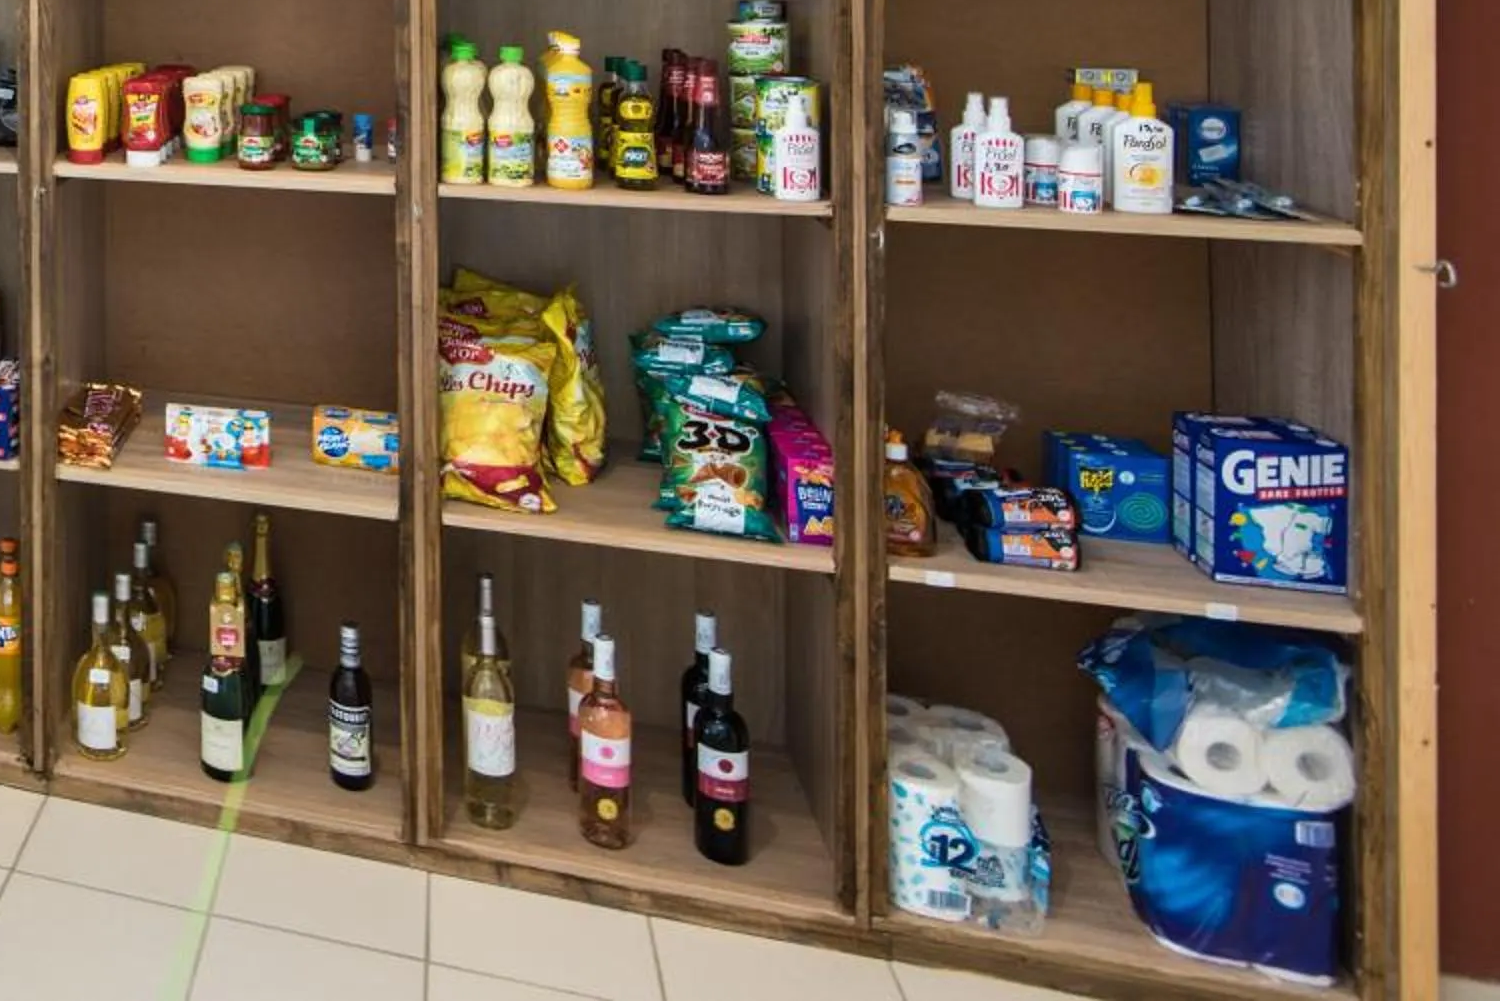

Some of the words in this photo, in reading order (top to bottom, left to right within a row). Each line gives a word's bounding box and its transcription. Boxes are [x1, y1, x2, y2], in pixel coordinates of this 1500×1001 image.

[468, 370, 536, 399] Chips
[1222, 450, 1345, 495] GENIE
[931, 834, 975, 867] 12
